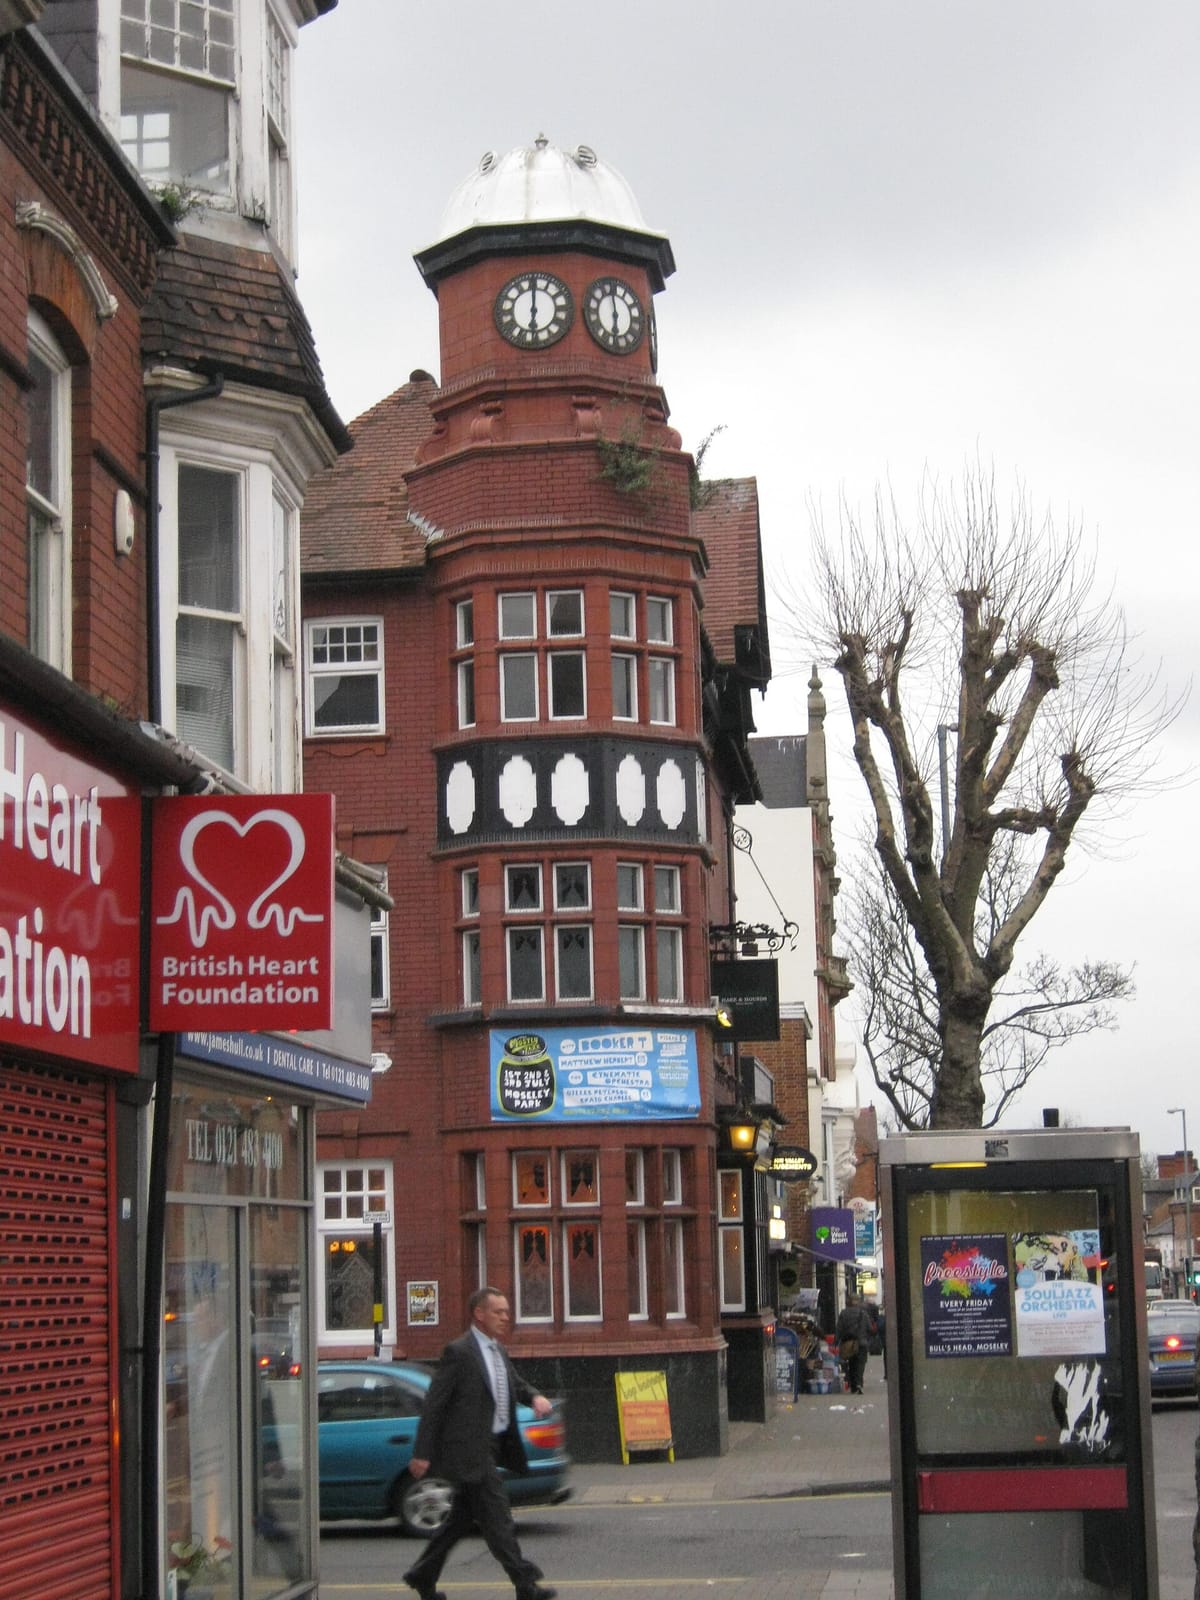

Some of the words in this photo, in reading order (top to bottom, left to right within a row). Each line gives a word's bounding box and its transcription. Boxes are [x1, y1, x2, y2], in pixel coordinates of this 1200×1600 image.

[162, 955, 243, 977] British
[248, 955, 319, 976] Heart
[162, 980, 319, 1005] Foundation
[581, 1037, 634, 1051] BOOKER
[638, 1037, 647, 1049] T
[273, 1049, 297, 1071] DENTAL
[298, 1056, 314, 1076] CARE
[322, 1063, 331, 1080] Tel
[331, 1066, 344, 1084] 0121
[560, 1058, 602, 1067] MATTHEW
[504, 1069, 521, 1079] 1ST
[523, 1070, 542, 1080] 2ND
[504, 1078, 522, 1088] 3RD
[524, 1077, 550, 1088] JULY
[504, 1088, 550, 1100] MOSELEY
[514, 1099, 542, 1109] PARK
[185, 1119, 213, 1161] TEL
[215, 1123, 239, 1167] 0121
[241, 1128, 259, 1168] 483
[923, 1259, 1008, 1287] freestyle
[1024, 1288, 1092, 1300] SOULJAZZ
[940, 1300, 963, 1308] EVERY
[966, 1299, 993, 1307] FRIDAY
[1021, 1300, 1097, 1312] ORCHESTRA
[929, 1344, 951, 1352] BULL'S
[976, 1342, 1009, 1351] MOSELEY
